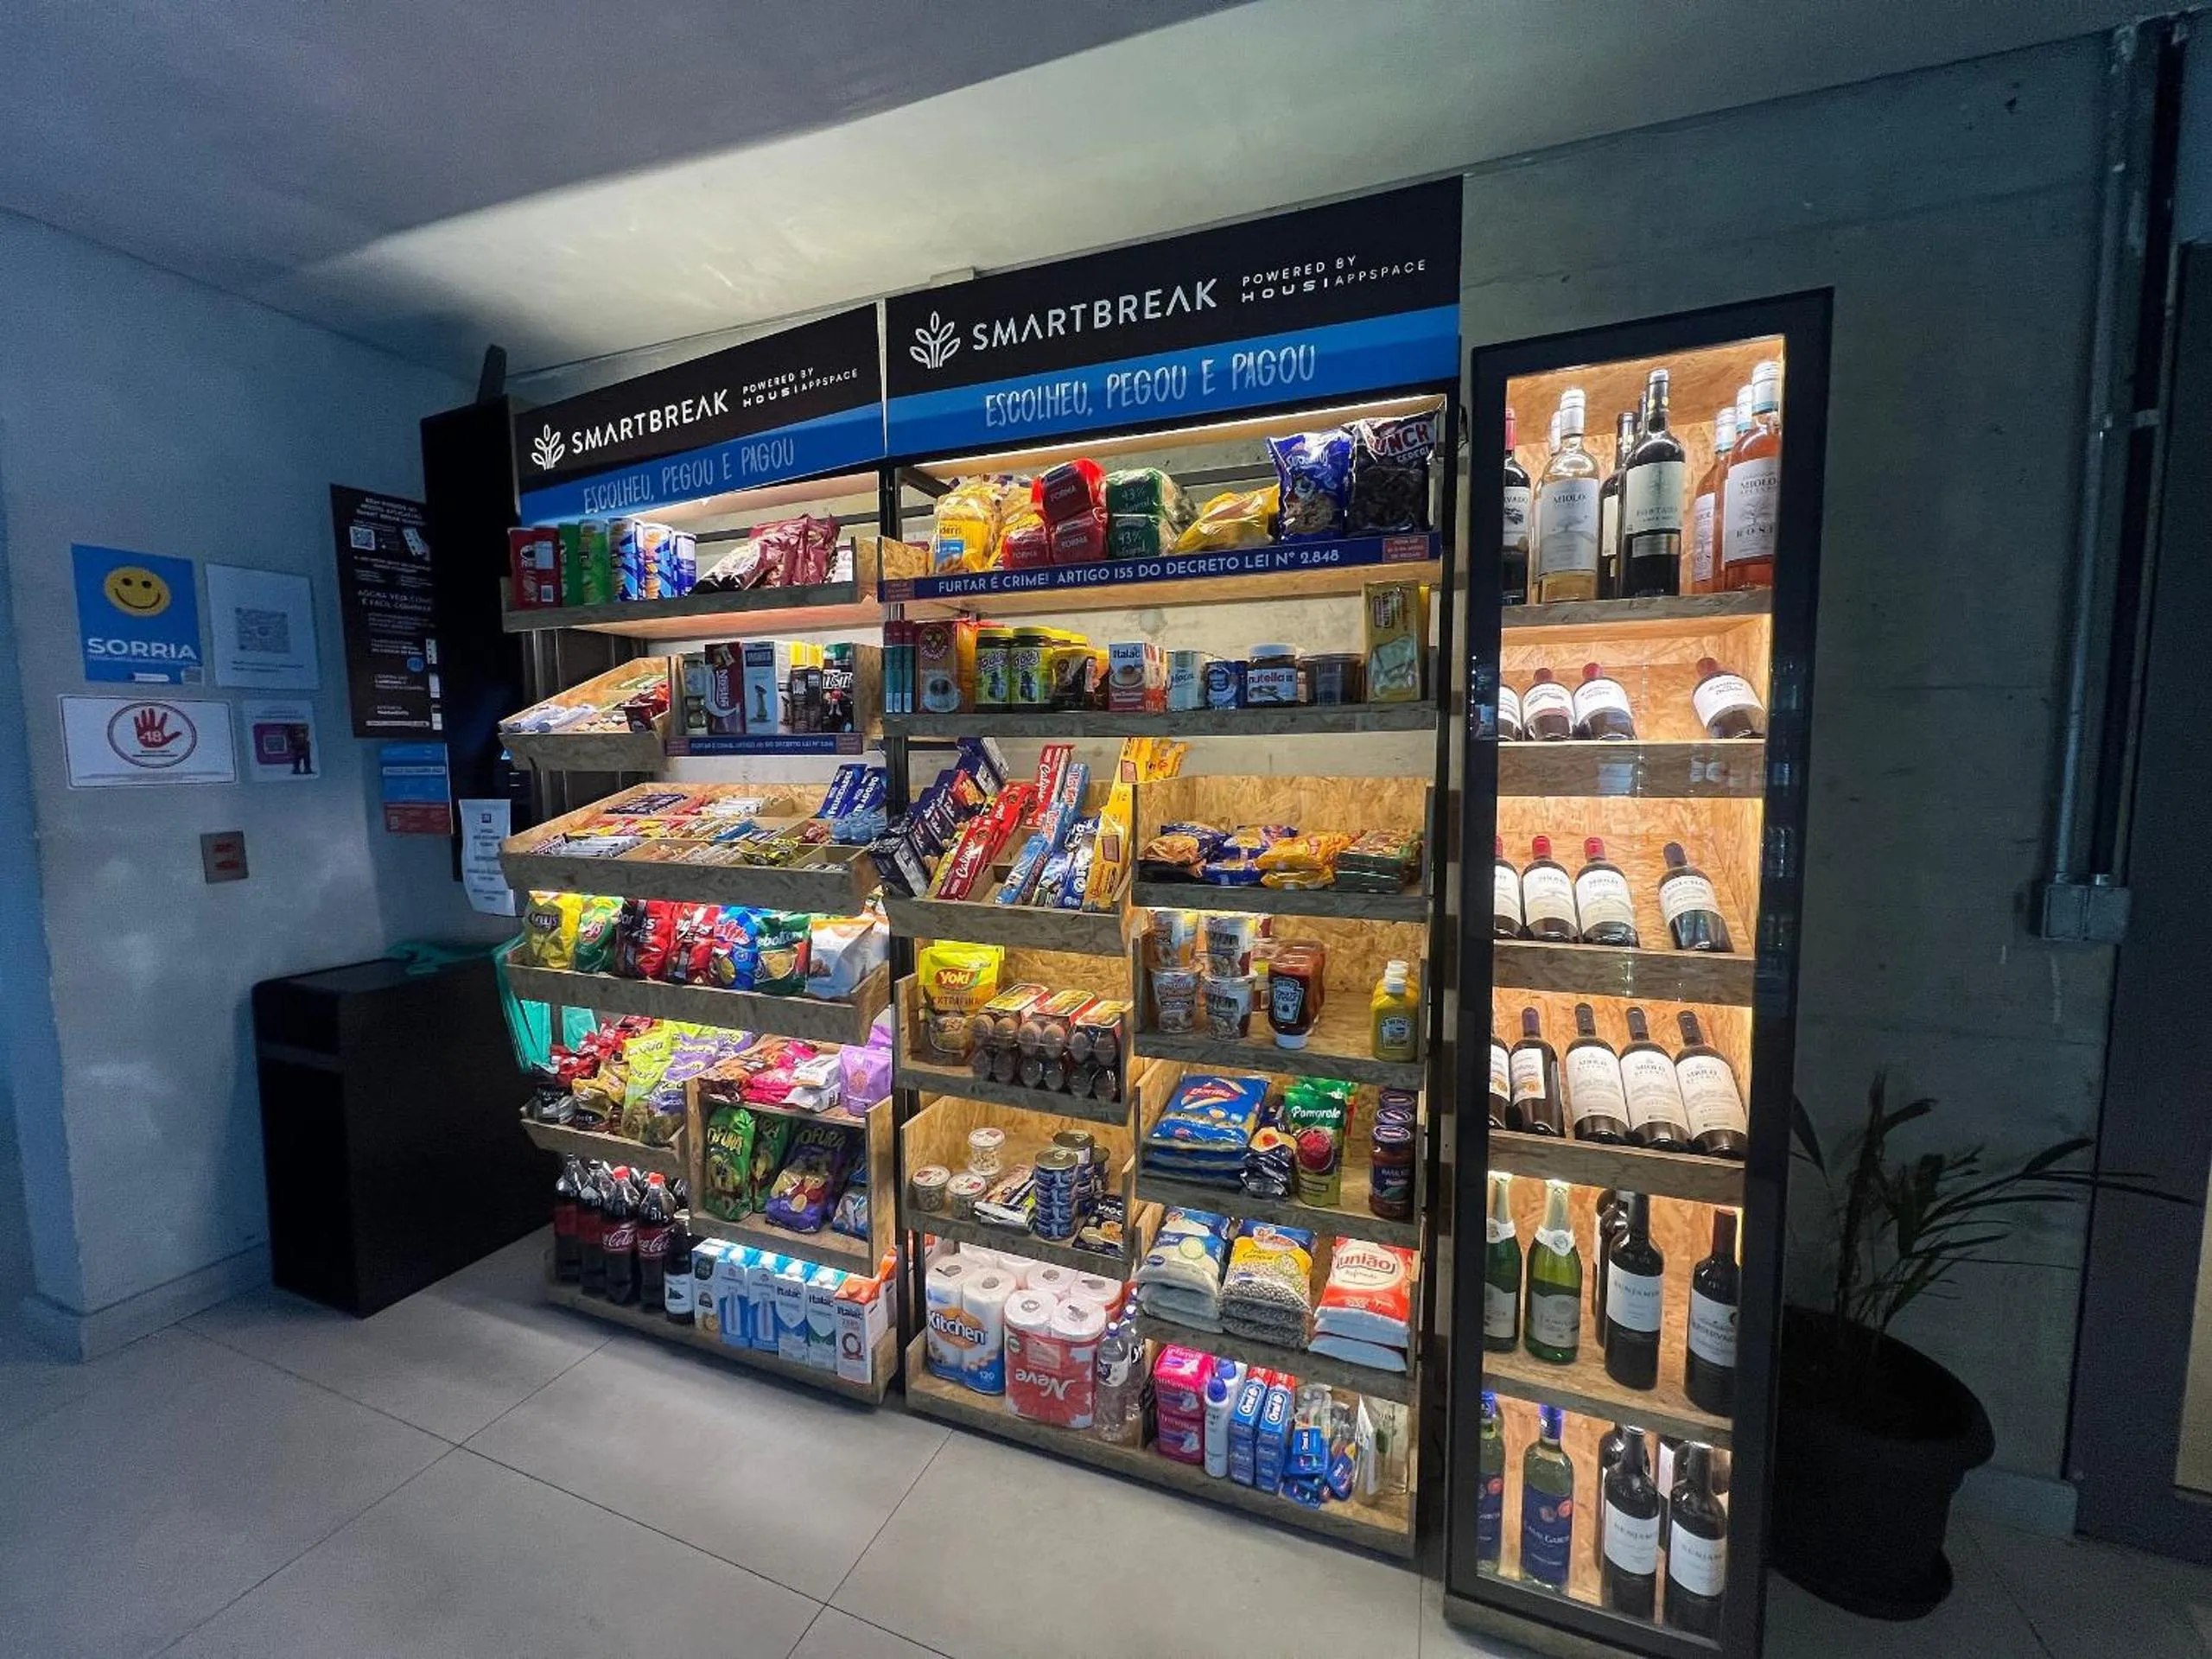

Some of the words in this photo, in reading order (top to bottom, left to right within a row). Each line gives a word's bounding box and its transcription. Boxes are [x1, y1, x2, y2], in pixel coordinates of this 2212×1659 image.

[1242, 262, 1326, 288] POWERED
[1336, 253, 1357, 270] BY
[1334, 259, 1427, 288] APPSPACE
[972, 277, 1218, 351] SMARTBREAK
[742, 372, 796, 394] POWERED
[799, 367, 815, 379] BY
[801, 368, 860, 391] APPSPACE
[984, 380, 1094, 428] ESCOLHEU,
[1106, 365, 1187, 408] PEGOU
[1201, 359, 1215, 392] E
[1230, 344, 1317, 391] PAGOU
[571, 389, 728, 454] SMARTBREAK
[583, 474, 655, 515] ESCOLHEU,
[662, 461, 714, 496] PEGOU
[722, 453, 732, 481] E
[741, 436, 795, 475] PAGOU
[938, 577, 986, 594] FURTAR
[1002, 572, 1051, 588] CRIME!
[1058, 567, 1109, 585] ARTIGO
[1138, 563, 1161, 577] DO
[1166, 556, 1240, 577] DECRETO
[1244, 553, 1270, 569] LEI
[1300, 548, 1339, 564] 2.848
[87, 637, 197, 660] SORRIA
[1248, 671, 1286, 684] nutella
[939, 970, 970, 986] Yoki
[929, 1310, 988, 1345] Kitchen
[1015, 1367, 1078, 1402] Neve
